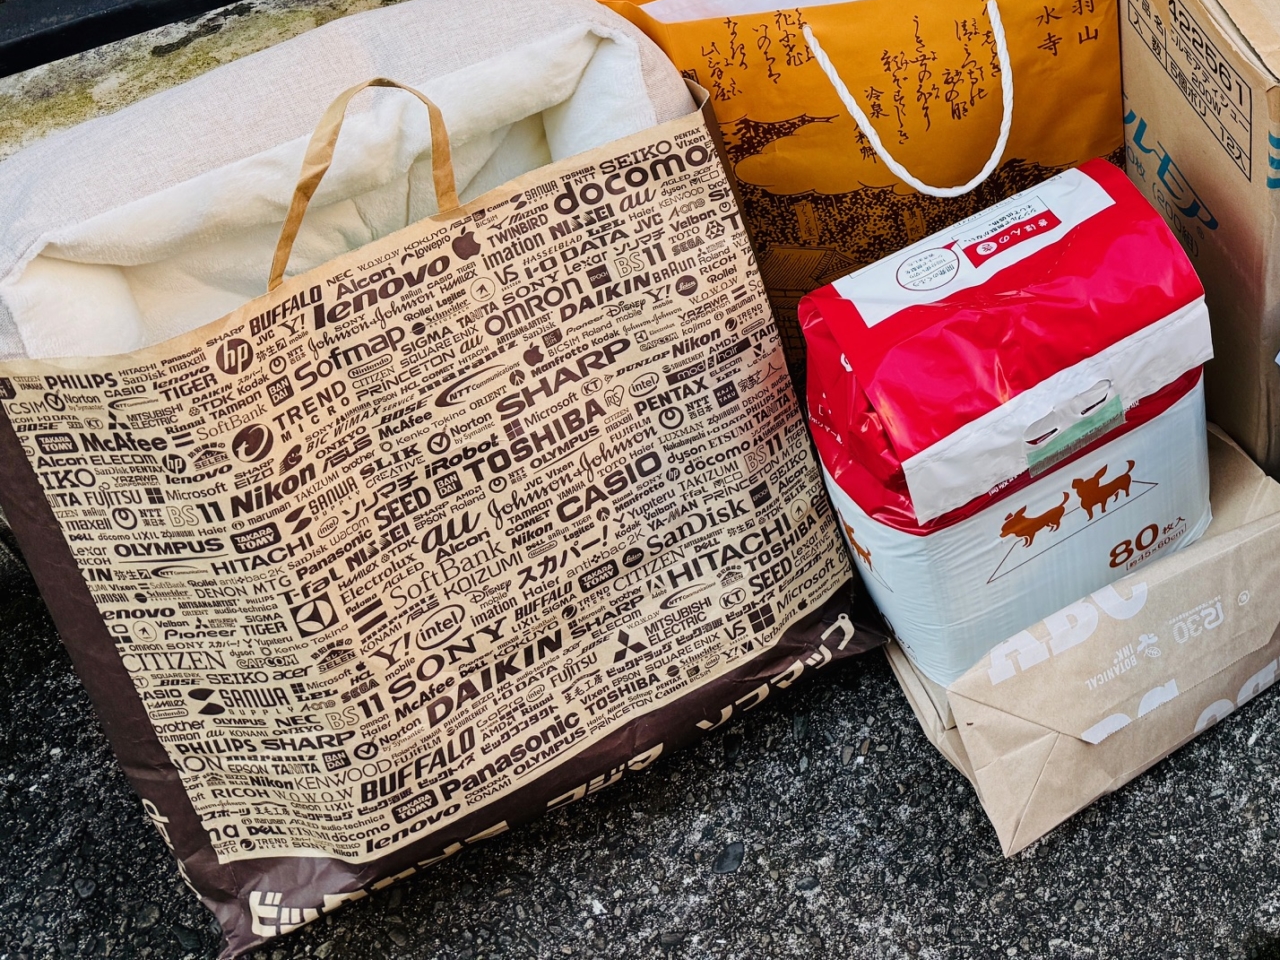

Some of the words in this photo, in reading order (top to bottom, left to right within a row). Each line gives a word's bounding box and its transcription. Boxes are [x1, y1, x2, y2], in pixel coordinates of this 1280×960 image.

[674, 127, 701, 141] PENTAX
[560, 166, 595, 182] TOSHIBA
[600, 140, 672, 175] SEIKO
[554, 145, 709, 215] docomo
[620, 187, 656, 212] au
[659, 187, 704, 209] KENWOOD
[487, 214, 548, 247] TWINBIRD
[549, 203, 615, 240] NISSEI
[634, 213, 663, 234] JVC
[670, 209, 716, 232] Velbon
[404, 228, 447, 252] KOKUYO
[414, 235, 450, 260] Lowepro
[481, 232, 545, 270] imation
[560, 229, 630, 264] DATA
[326, 269, 353, 287] NEC
[699, 253, 737, 276] RICOH
[313, 255, 451, 331] lenovo
[336, 266, 396, 301] Alcon
[560, 272, 649, 322] DAIKIN
[249, 284, 322, 337] BUFFALO
[206, 325, 245, 348] SHARP
[400, 338, 451, 368] SQUARE
[454, 324, 479, 343] ENIX
[401, 326, 454, 356] SIGMA
[294, 326, 405, 392] Sofmap
[616, 350, 670, 378] DUNLOP
[44, 373, 118, 390] PHILIPS
[104, 384, 146, 398] CASIO
[123, 369, 167, 385] SanDisk
[160, 373, 218, 402] TIGER
[352, 366, 396, 390] CITIZEN
[496, 339, 631, 421] SHARP
[63, 394, 100, 403] Norton
[127, 403, 184, 422] MITSUBISHI
[209, 391, 262, 420] TAMRON
[272, 380, 346, 431] TREND
[524, 392, 579, 428] Microsoft
[633, 376, 709, 416] PENTAX
[17, 422, 63, 432] BOSE
[130, 415, 179, 430] ELECTRIC
[197, 401, 268, 441] SoftBank
[79, 432, 168, 452] McAfee
[316, 426, 366, 459] ONKYO
[425, 433, 500, 479] iRobot
[463, 398, 606, 483] TOSHIBA
[89, 455, 158, 466] ELECOM
[342, 449, 375, 473] brother
[684, 441, 750, 475] docomo
[85, 482, 142, 508] FUJITSU
[166, 481, 229, 503] Microsoft
[231, 462, 316, 519] Nikon
[556, 450, 662, 523] CASIO
[66, 518, 112, 531] maxell
[374, 486, 431, 531] SEED
[647, 498, 750, 556] SanDisk
[114, 538, 224, 558] OLYMPUS
[211, 532, 314, 576] HITACHI
[296, 529, 373, 580] Panasonic
[667, 514, 792, 588] HITACHI
[1108, 522, 1160, 570] 80
[339, 553, 417, 606] Electrolux
[444, 551, 523, 600] KOIZUMI
[165, 629, 236, 640] Pioneer
[122, 650, 227, 672] CITIZEN
[388, 616, 507, 703] SONY
[1085, 651, 1138, 691] BOTANICAL
[427, 628, 562, 728] DAIKIN
[361, 726, 475, 803] BUFFALO
[439, 711, 580, 800] Panasonic
[366, 804, 461, 853] lenovo
